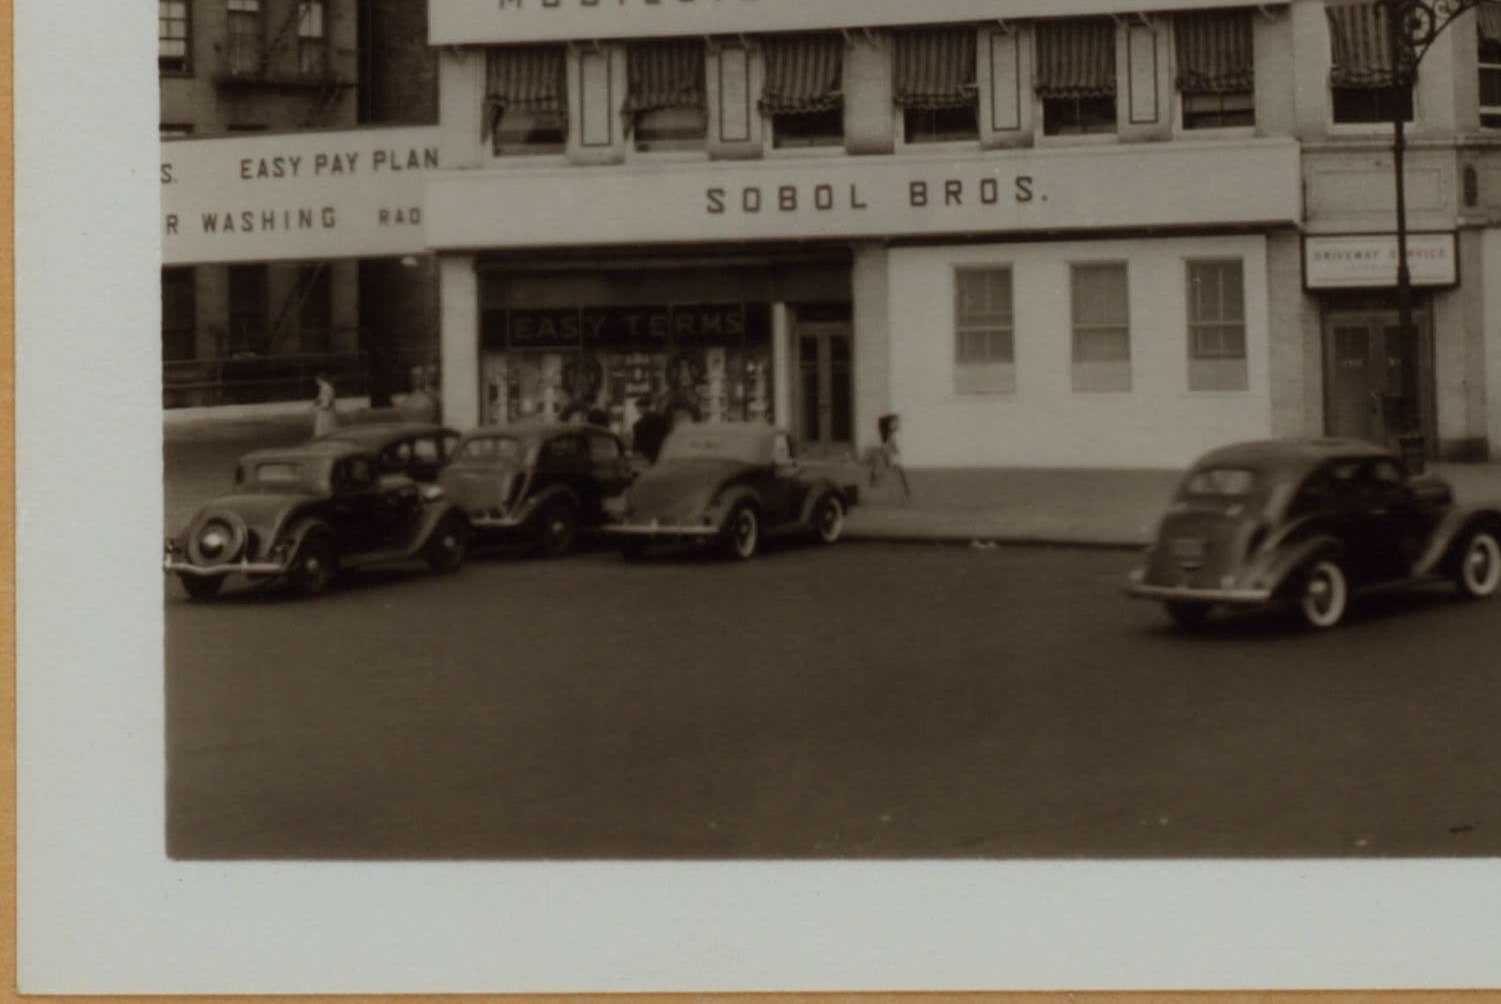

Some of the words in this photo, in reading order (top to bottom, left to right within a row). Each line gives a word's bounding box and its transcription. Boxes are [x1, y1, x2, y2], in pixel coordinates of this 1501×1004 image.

[240, 156, 302, 180] EASY
[314, 152, 358, 176] PAY
[373, 148, 439, 172] PLAN
[707, 183, 867, 214] SOBOL
[910, 176, 1049, 206] BROS.
[202, 207, 336, 233] WASHING
[513, 316, 606, 341] EASY
[625, 311, 743, 338] TERMS
